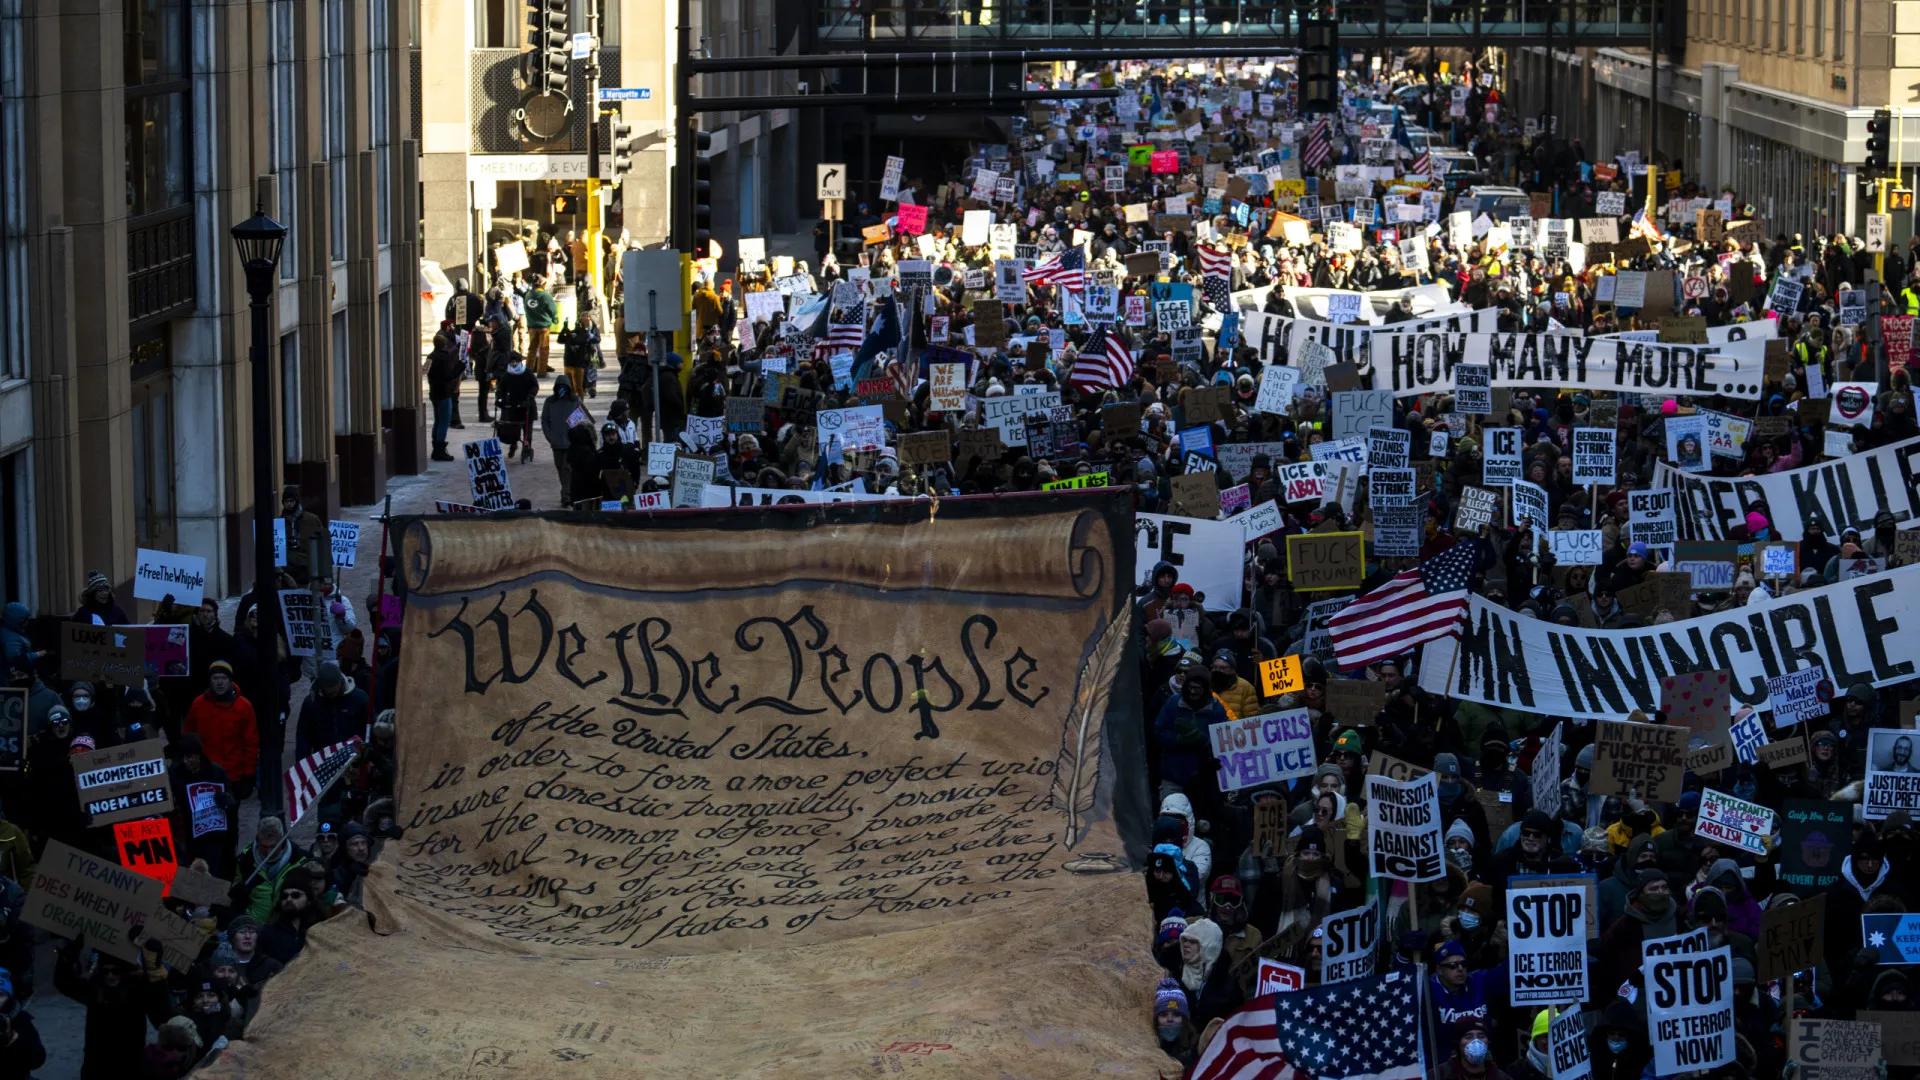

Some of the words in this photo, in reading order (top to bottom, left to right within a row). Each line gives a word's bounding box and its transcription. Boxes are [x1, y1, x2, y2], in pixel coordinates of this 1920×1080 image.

[608, 91, 638, 99] Marquette
[481, 163, 544, 172] MEETINGS
[564, 162, 611, 172] EVETS
[1870, 217, 1883, 226] ONE
[1871, 227, 1883, 236] WAY
[1015, 245, 1037, 258] STOP
[1159, 302, 1188, 311] ICE
[1160, 311, 1188, 320] OUT
[1160, 321, 1189, 330] NOW
[936, 365, 954, 375] WE
[1391, 333, 1468, 392] HOW
[1489, 332, 1595, 382] MANY
[934, 376, 953, 385] ARE
[1267, 370, 1291, 381] END
[1457, 375, 1488, 387] GENERAL
[1266, 380, 1285, 390] THE
[987, 400, 1021, 419] ICE
[1025, 396, 1058, 411] LIKES
[1339, 394, 1389, 413] FUCK
[1370, 428, 1409, 441] MINNESOTA
[1493, 431, 1515, 455] ICE
[1576, 431, 1613, 442] GENERAL
[650, 444, 673, 455] ICE
[1372, 440, 1404, 453] STANDS
[649, 460, 673, 470] GTFO
[677, 459, 695, 470] LOVE
[1188, 452, 1217, 469] END
[1369, 453, 1408, 468] AGAINST
[1575, 455, 1587, 465] THE
[1589, 455, 1606, 465] PATH
[1607, 455, 1613, 465] TO
[1282, 463, 1309, 480] ICE
[1372, 471, 1413, 482] GENERAL
[1486, 466, 1521, 477] MINNESOTA
[1575, 466, 1613, 477] JUSTICE
[640, 493, 661, 508] HOT
[1372, 496, 1385, 506] THE
[1386, 496, 1402, 505] PATH
[1633, 494, 1649, 511] ICE
[1650, 492, 1671, 510] OUT
[1250, 506, 1274, 523] AGENTS
[330, 521, 359, 530] FREEDOM
[1256, 517, 1277, 532] UGLY
[1632, 521, 1674, 533] MINNESOTA
[331, 529, 356, 540] AND
[1554, 532, 1601, 551] FUCK
[1298, 542, 1358, 564] FUCK
[1560, 551, 1594, 563] ICE
[1767, 550, 1791, 558] LOVE
[138, 564, 204, 590] #FreeTheWhipple
[1296, 567, 1358, 585] TRUMP
[1680, 562, 1734, 587] STRONG
[72, 629, 106, 646] LEAVE
[1458, 607, 1536, 707] MN
[1547, 578, 1915, 714] INVINCIBLE
[427, 589, 608, 694] We
[735, 604, 1050, 738] People
[1268, 660, 1287, 670] ICE
[1269, 668, 1290, 680] OUT
[1272, 679, 1293, 691] NOW
[1786, 684, 1815, 703] Make
[1775, 696, 1819, 717] America
[1796, 705, 1827, 722] Great
[491, 702, 543, 746] of
[532, 705, 606, 738] the
[612, 718, 736, 760] United
[1216, 719, 1260, 753] HOT
[1603, 723, 1627, 741] MN
[1631, 727, 1676, 747] NICE
[1731, 715, 1760, 748] ICE
[1597, 741, 1682, 767] FUCKING
[81, 761, 162, 787] INCOMPETENT
[421, 762, 465, 792] in
[477, 737, 581, 778] order
[583, 752, 630, 777] to
[613, 764, 713, 794] form
[824, 752, 976, 798] perfect
[1217, 748, 1271, 790] MELT
[1275, 747, 1313, 772] ICE
[1612, 761, 1667, 783] HATES
[1869, 774, 1911, 790] JUSTICE
[89, 798, 129, 815] NOEM
[141, 789, 163, 804] ICE
[401, 785, 510, 831] insure
[524, 772, 673, 817] domestic
[874, 777, 1031, 818] provide
[1371, 781, 1434, 806] MINNESOTA
[1868, 790, 1893, 806] ALEX
[1379, 802, 1432, 827] STANDS
[1703, 801, 1720, 812] ARE
[1706, 791, 1773, 820] IMMIGRANTS
[1260, 803, 1284, 828] ICE
[1720, 815, 1744, 829] HERE
[1788, 810, 1808, 823] Only
[1810, 810, 1825, 822] You
[407, 831, 464, 857] for
[476, 802, 540, 849] the
[556, 816, 680, 846] common
[845, 798, 997, 841] promote
[746, 838, 821, 857] and
[826, 827, 960, 857] secure
[970, 814, 1034, 836] the
[1698, 822, 1742, 844] ABOLISH
[1373, 829, 1438, 857] AGAINST
[123, 838, 174, 867] MN
[618, 864, 669, 894] of
[825, 854, 869, 874] to
[881, 830, 1056, 866] ourselves
[839, 861, 968, 887] ordain
[985, 843, 1058, 867] and
[1375, 853, 1441, 879] ICE
[67, 852, 145, 895] TYRANNY
[888, 871, 978, 899] for
[992, 862, 1058, 884] the
[1782, 874, 1816, 887] PREVENT
[35, 874, 71, 899] DIES
[73, 887, 119, 919] WHEN
[123, 908, 145, 925] WE
[840, 889, 1012, 920] America
[42, 903, 121, 946] ORGANIZE
[1513, 894, 1582, 939] STOP
[1327, 901, 1378, 957] STOP
[1766, 913, 1817, 948] DE-ICE
[1514, 954, 1535, 973] ICE
[1537, 951, 1582, 972] TERROR
[1770, 938, 1815, 975] MN!
[1326, 964, 1345, 982] ICE
[1515, 972, 1583, 988] NOW!
[1654, 955, 1729, 1008] STOP
[1516, 991, 1529, 999] PARTY
[1530, 990, 1538, 998] FOR
[1538, 989, 1560, 998] SOCIALISM
[1657, 1018, 1681, 1041] ICE
[1682, 1008, 1731, 1037] TERROR
[1675, 1034, 1723, 1066] NOW!
